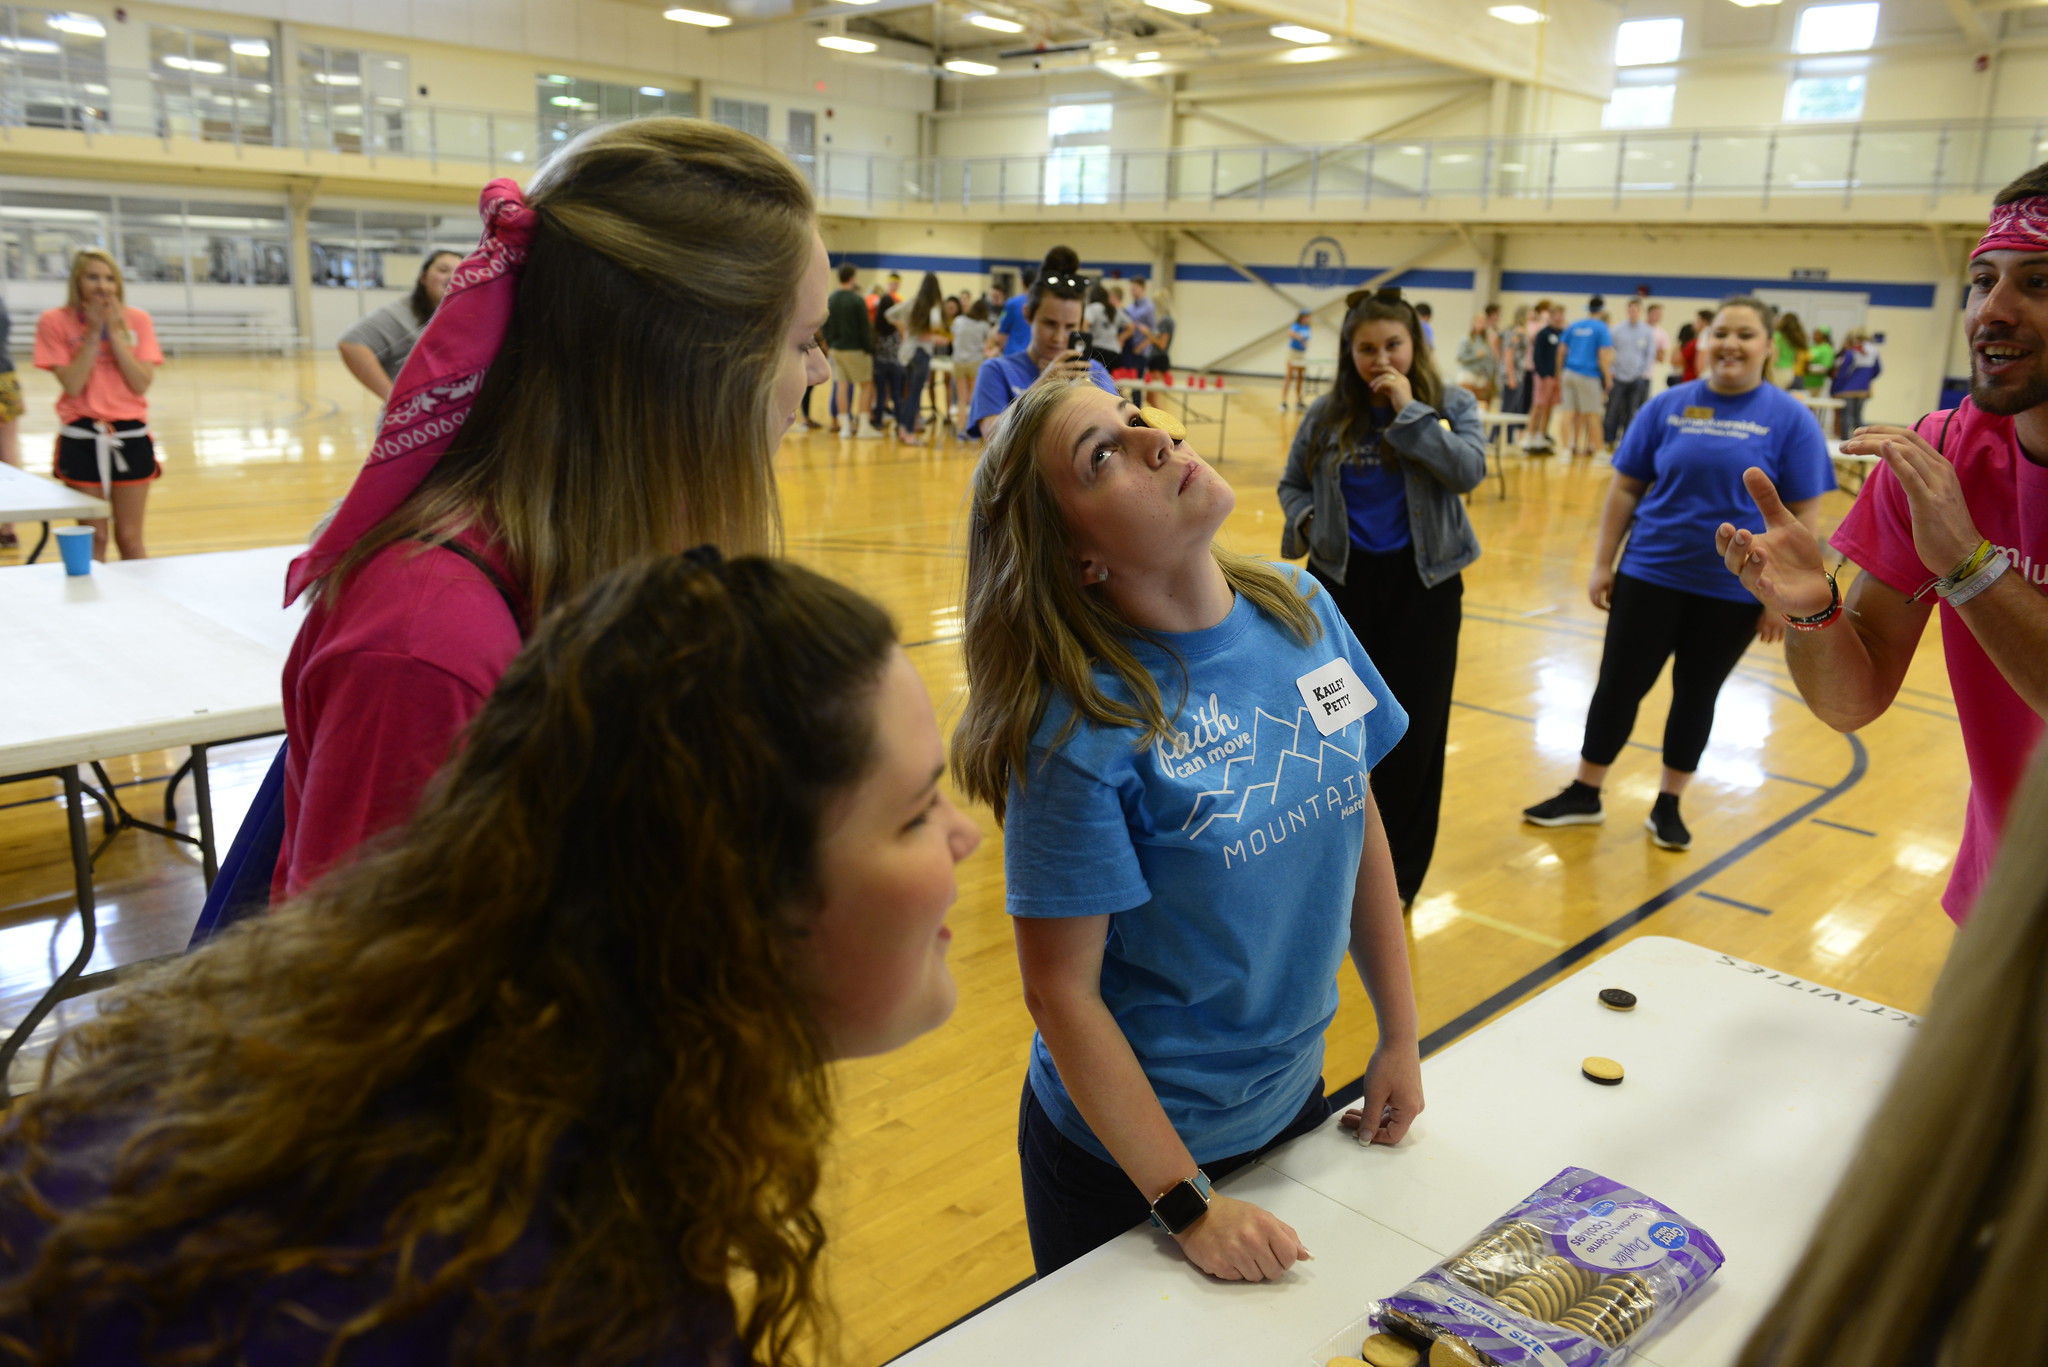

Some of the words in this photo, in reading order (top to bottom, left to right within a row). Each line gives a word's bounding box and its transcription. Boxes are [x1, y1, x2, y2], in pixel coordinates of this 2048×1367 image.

[1156, 692, 1239, 779] faith
[1176, 755, 1208, 779] can
[1207, 731, 1252, 764] move
[1570, 1220, 1612, 1247] Cookies
[1652, 1225, 1671, 1240] Value
[1659, 1227, 1684, 1247] Great
[1609, 1237, 1650, 1267] Duplex
[1446, 1296, 1510, 1330] FAMILY
[1508, 1329, 1545, 1356] SIZE
